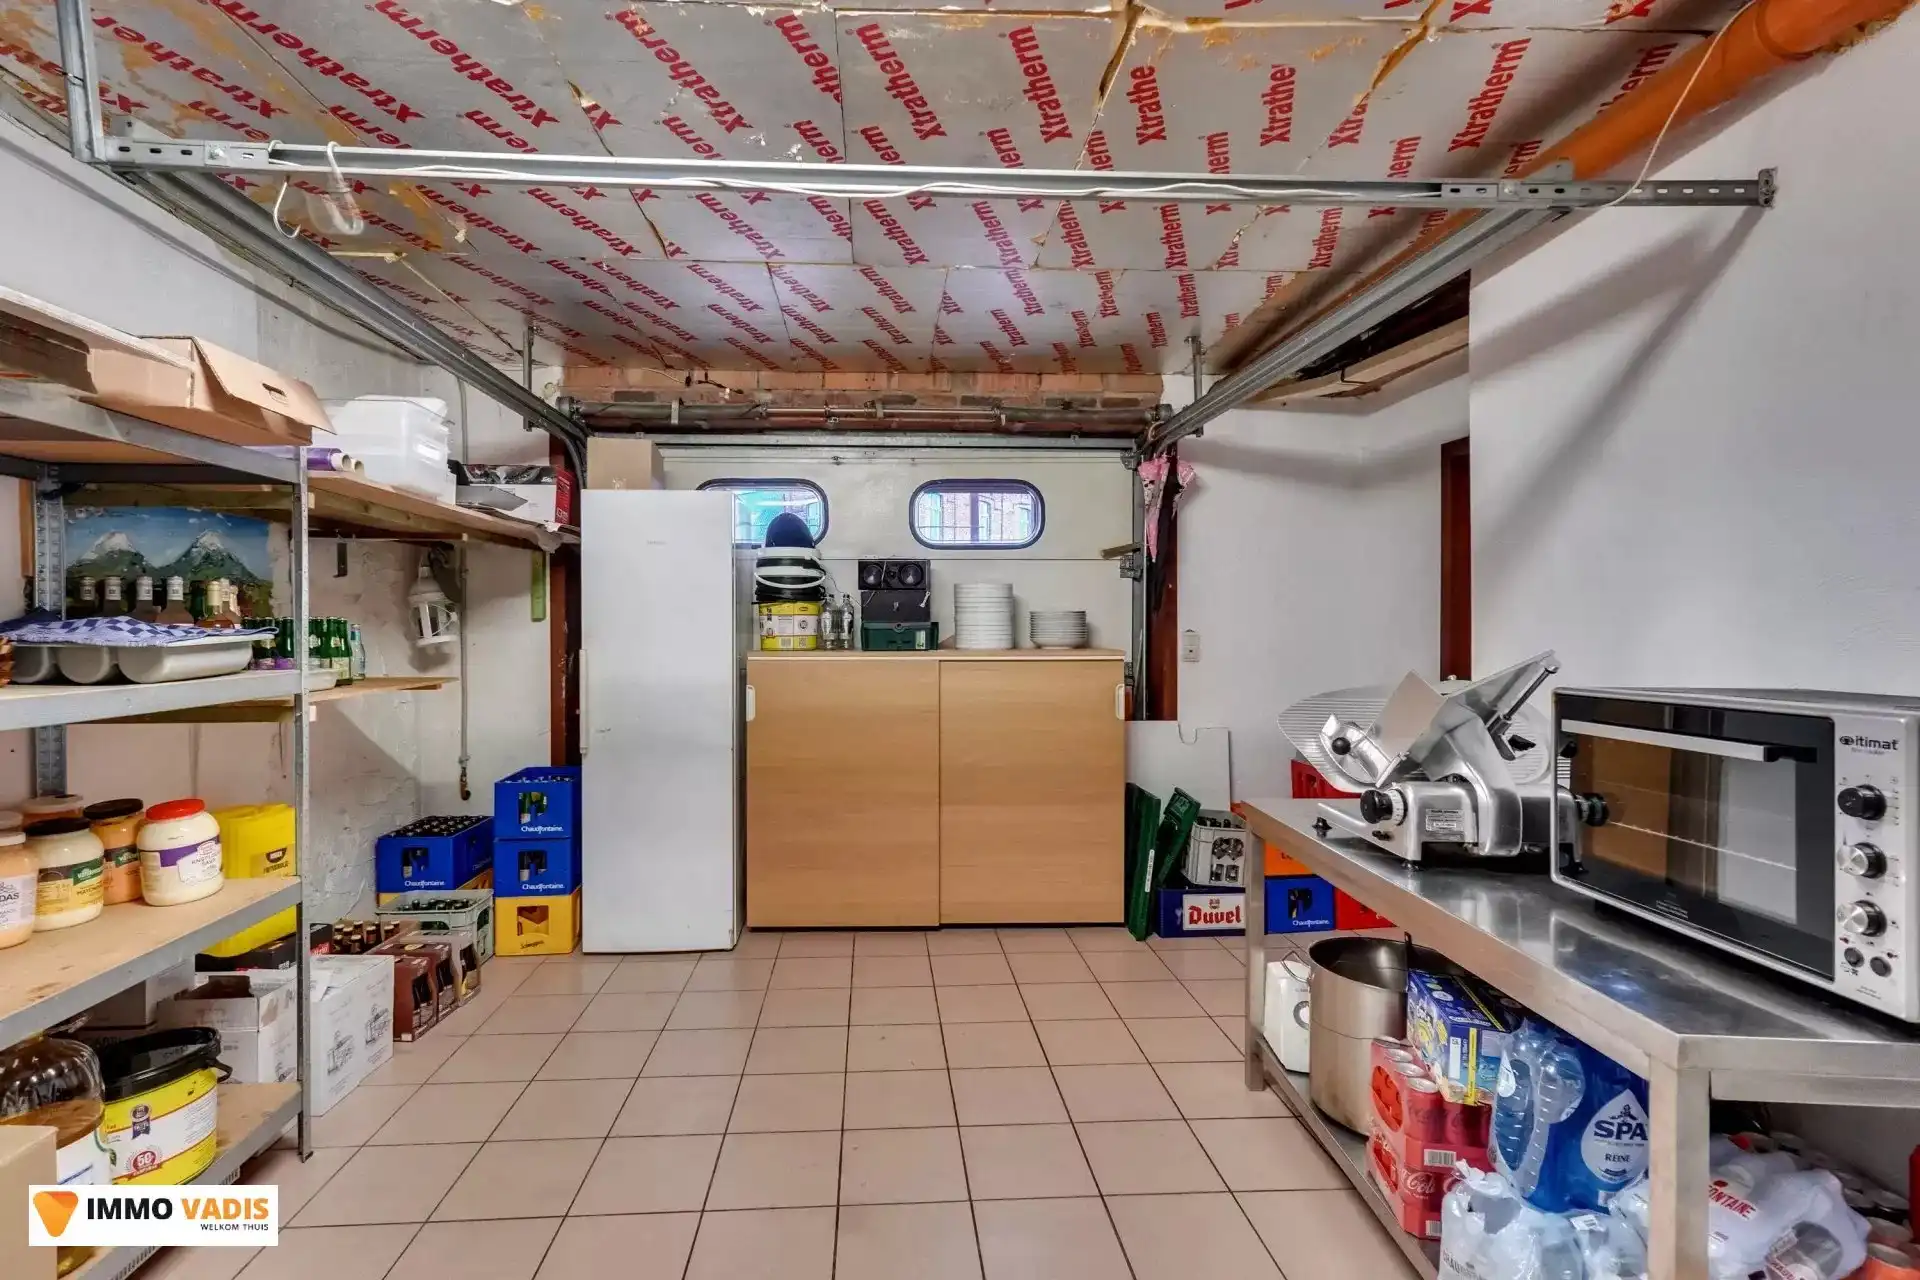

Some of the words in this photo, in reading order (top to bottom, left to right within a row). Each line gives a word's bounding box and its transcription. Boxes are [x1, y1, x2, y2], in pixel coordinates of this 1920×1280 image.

[207, 0, 425, 123] Xtratherm
[374, 0, 559, 128] Xtratherm
[614, 10, 753, 134] Xtratherm
[856, 23, 947, 141] Xtratherm
[1008, 25, 1073, 143] Xtratherm
[1448, 38, 1531, 152] Xtratherm
[414, 184, 542, 256] Xtratherm
[527, 187, 641, 256] Xtratherm
[695, 192, 785, 259] Xtratherm
[863, 200, 930, 265] Xtratherm
[972, 201, 1022, 266] Xtratherm
[1160, 203, 1188, 270] Xtratherm
[1308, 207, 1342, 269] Xtratherm
[684, 264, 765, 312] Xtratherm
[859, 267, 916, 314] Xtratherm
[1005, 267, 1045, 317] Xtratherm
[1095, 270, 1121, 318] Xtratherm
[1178, 273, 1200, 319] Xtratherm
[623, 302, 698, 342] Xtratherm
[707, 303, 776, 344] Xtratherm
[861, 306, 913, 345] Xtratherm
[990, 308, 1029, 347] Xtratherm
[1147, 312, 1169, 348] Xtratherm
[1188, 904, 1242, 925] Duvel
[1593, 1119, 1649, 1141] SPA
[1605, 1153, 1631, 1162] REINE
[1708, 1184, 1756, 1221] ONTAINE
